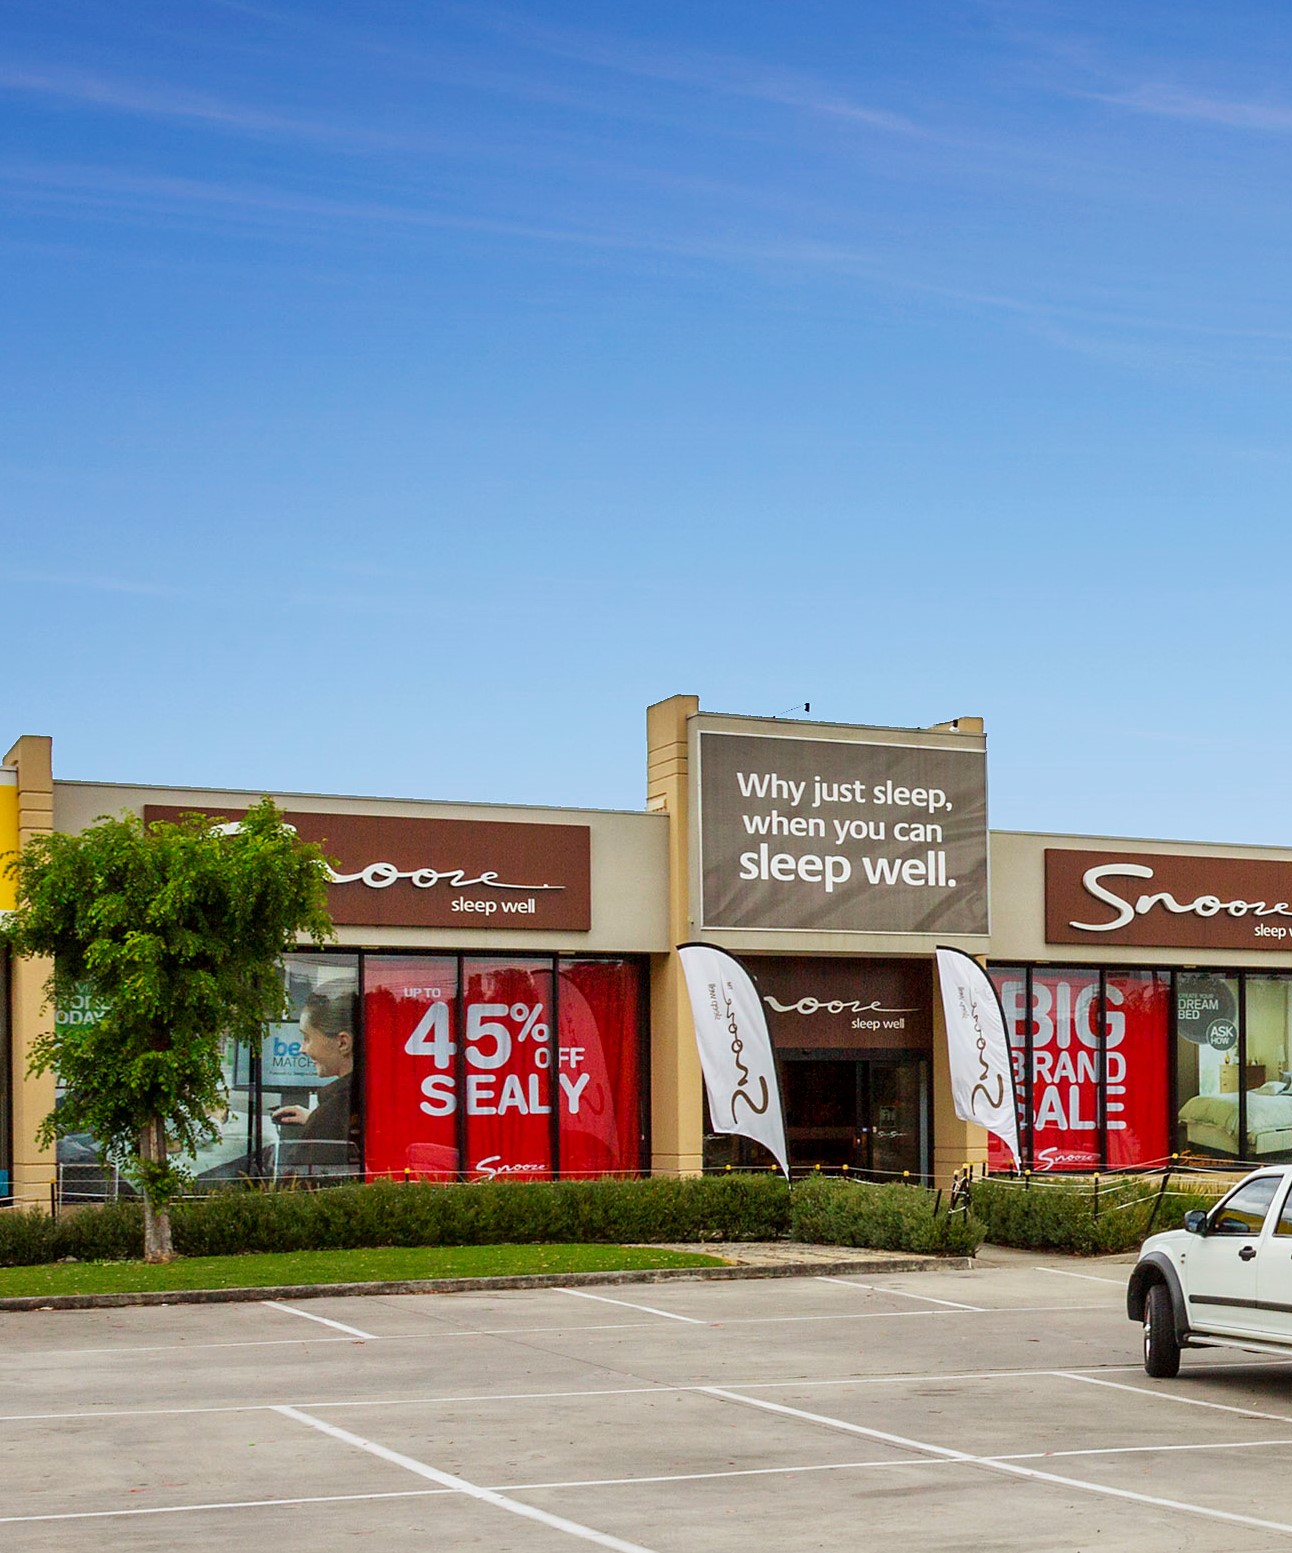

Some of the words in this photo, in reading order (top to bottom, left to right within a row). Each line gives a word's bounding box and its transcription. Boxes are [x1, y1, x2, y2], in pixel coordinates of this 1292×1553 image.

[736, 772, 806, 806] Why
[812, 776, 866, 807] just
[873, 780, 953, 814] sleep,
[742, 810, 826, 838] when
[833, 819, 886, 845] you
[893, 823, 943, 843] can
[739, 843, 851, 893] sleep
[862, 850, 957, 888] well.
[451, 896, 497, 915] sleep
[501, 898, 536, 914] well
[1254, 923, 1287, 940] sleep
[404, 988, 422, 998] UP
[425, 988, 441, 998] TO
[762, 995, 922, 1015] ooze
[1001, 981, 1126, 1049] BIG
[1178, 999, 1219, 1010] DREAM
[1178, 1010, 1200, 1020] BED
[404, 1001, 550, 1069] 45%
[851, 1018, 880, 1031] sleep
[883, 1018, 905, 1030] well
[1210, 1026, 1233, 1037] ASK
[1210, 1037, 1230, 1045] HOW
[534, 1047, 586, 1069] OFF
[1011, 1050, 1127, 1084] BRAND
[419, 1073, 590, 1117] SEALY
[472, 1155, 548, 1180] Snooze
[1035, 1147, 1097, 1171] Snooze
